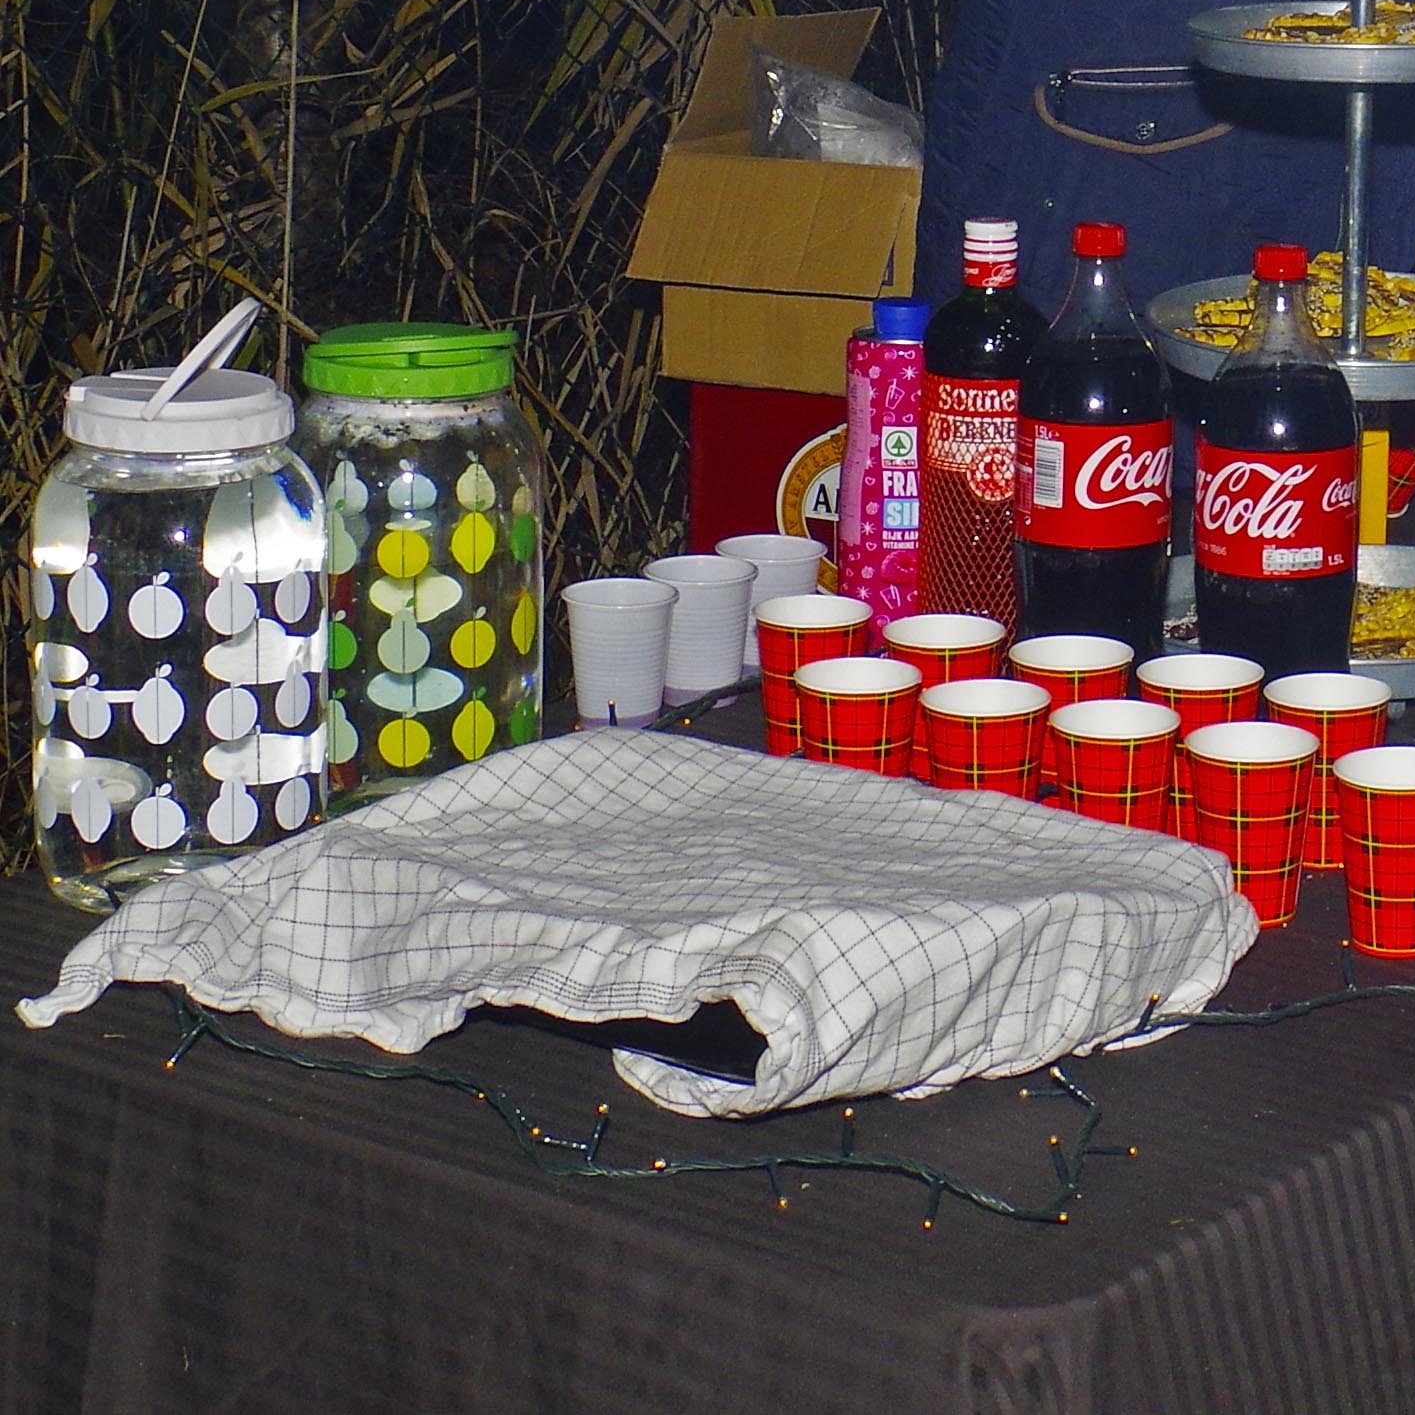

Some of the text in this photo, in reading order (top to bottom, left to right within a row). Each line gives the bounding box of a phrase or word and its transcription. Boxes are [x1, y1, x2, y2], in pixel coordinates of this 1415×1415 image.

[938, 384, 1017, 412] Sonne
[882, 470, 920, 496] FRA
[1075, 435, 1173, 509] Coca
[1322, 478, 1357, 511] Coca
[882, 530, 903, 540] RIJK
